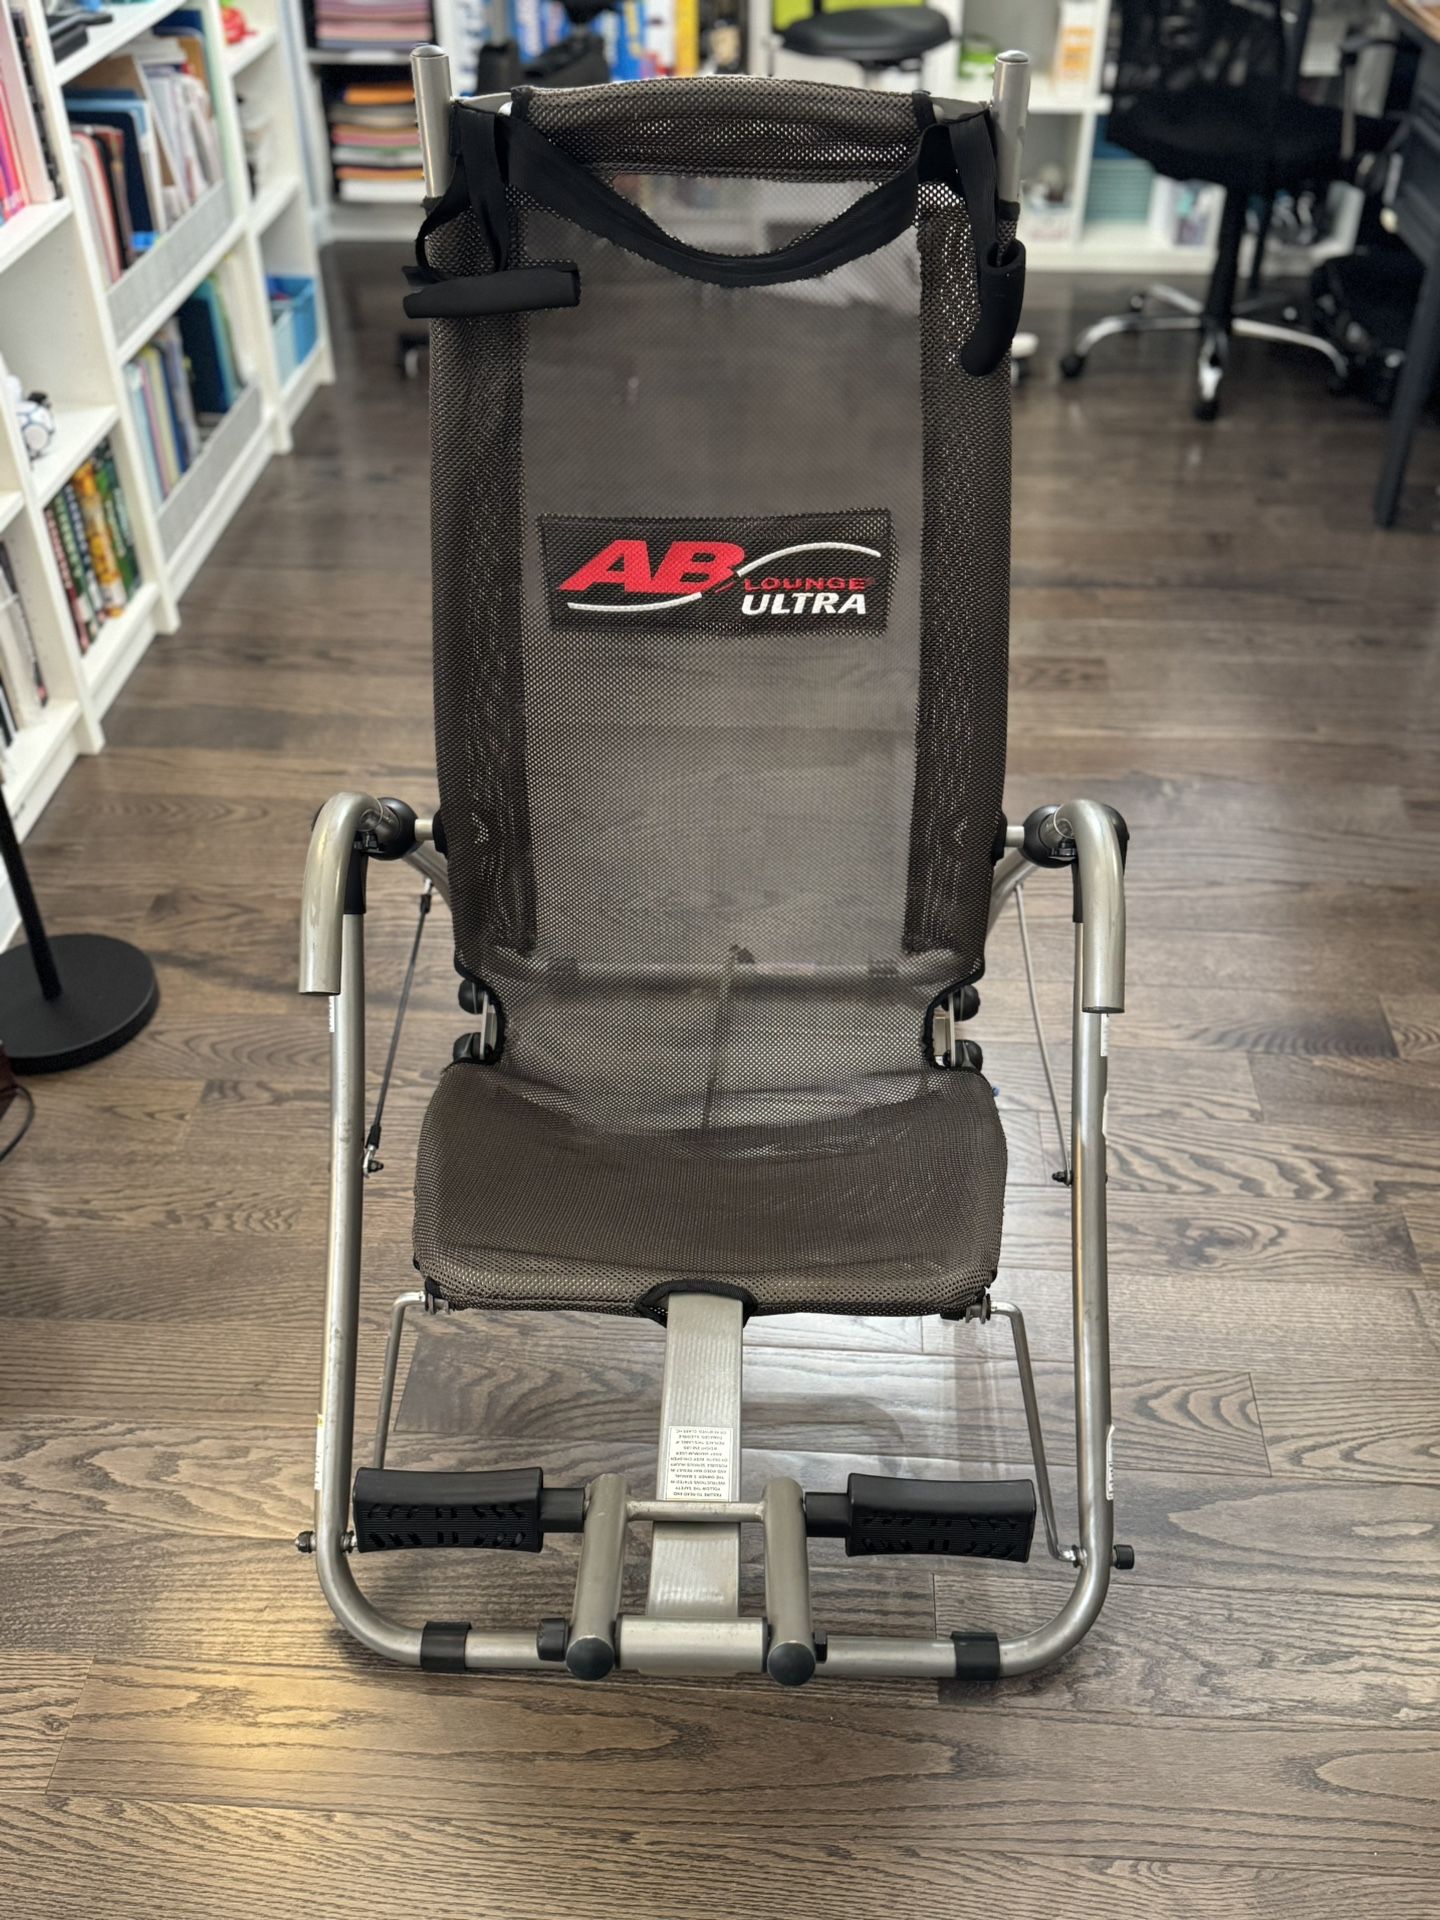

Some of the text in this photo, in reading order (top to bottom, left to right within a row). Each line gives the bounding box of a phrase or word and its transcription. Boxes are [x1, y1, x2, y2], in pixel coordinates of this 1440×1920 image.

[559, 539, 745, 594] AB
[744, 577, 867, 593] LOUNGE
[741, 592, 867, 616] ULTRA
